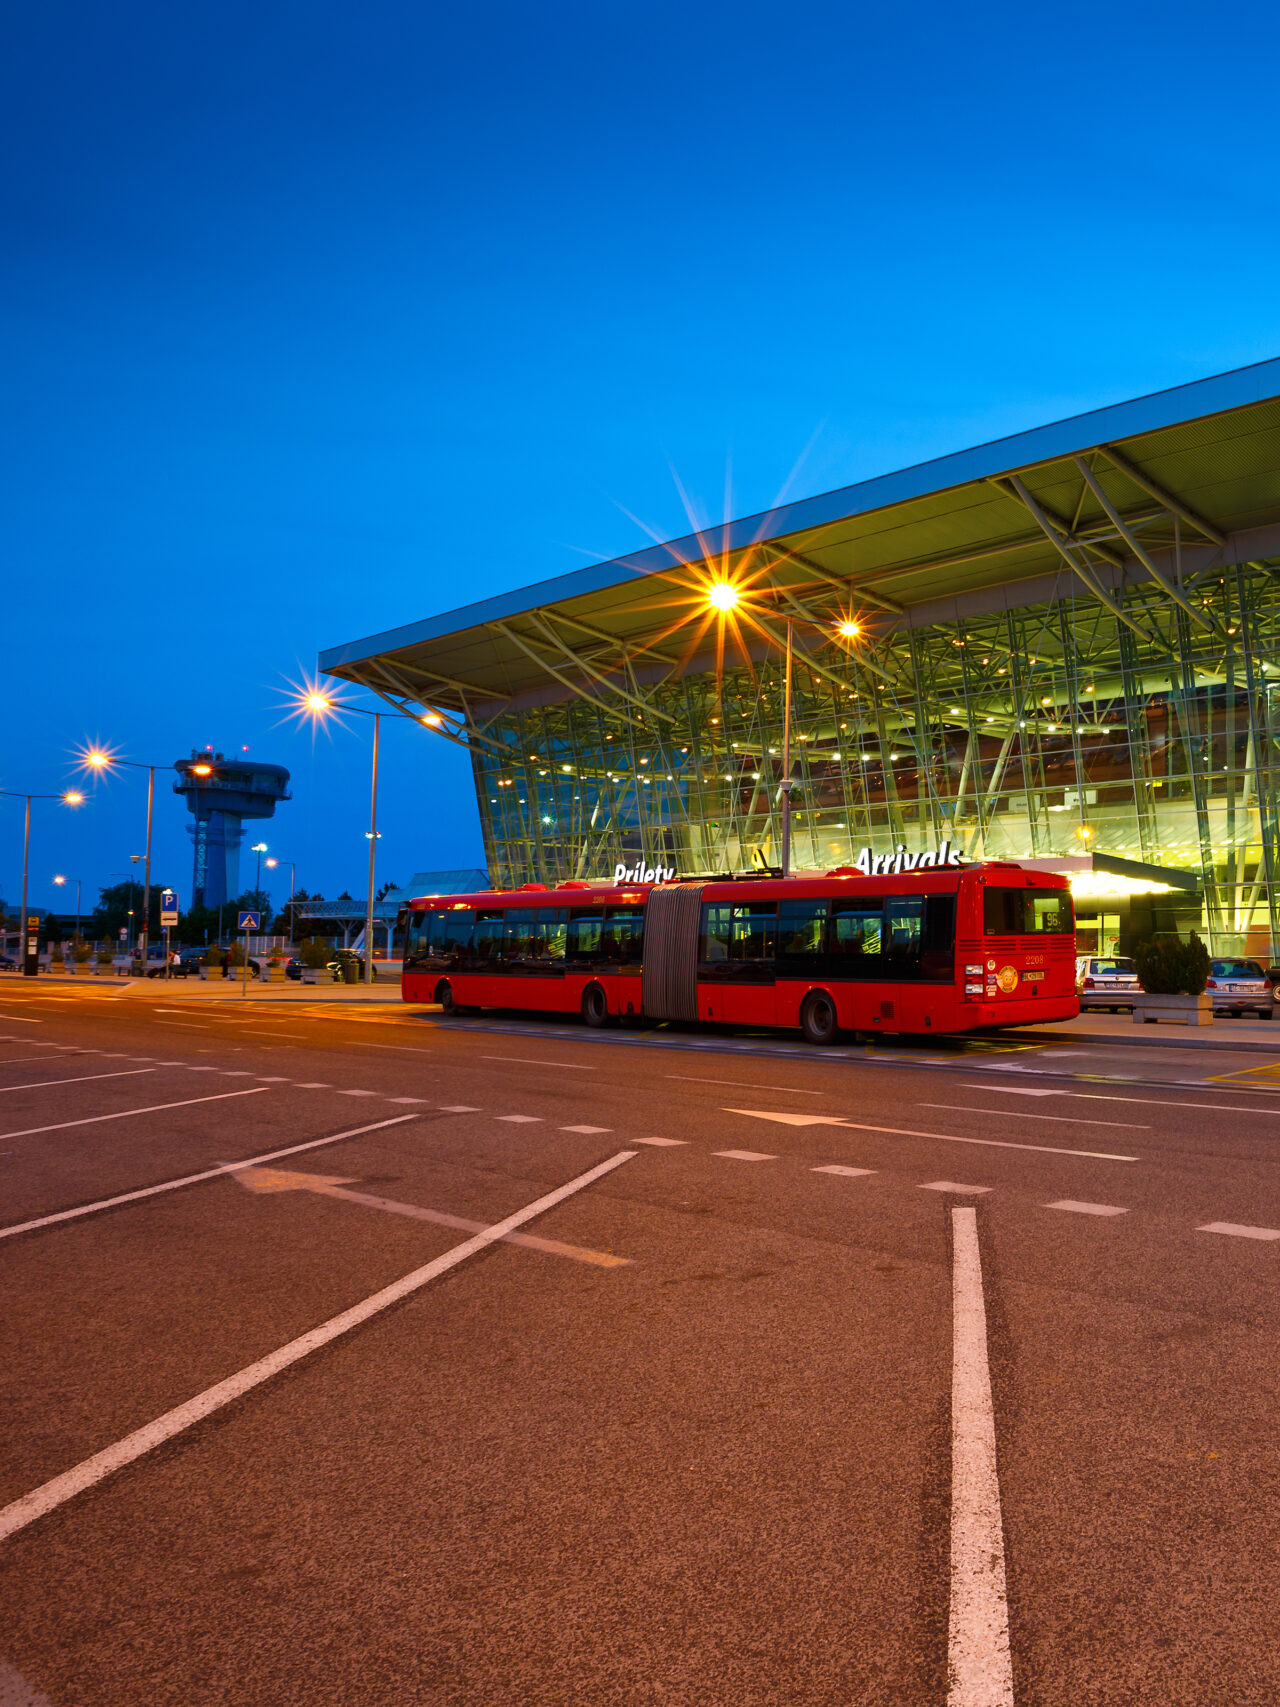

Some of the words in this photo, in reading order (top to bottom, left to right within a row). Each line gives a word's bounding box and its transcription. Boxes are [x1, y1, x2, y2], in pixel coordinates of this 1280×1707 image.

[856, 841, 961, 876] Arrivals
[613, 861, 675, 888] Prílety
[165, 895, 174, 907] P
[1046, 912, 1059, 927] 96
[1025, 955, 1044, 965] 2208
